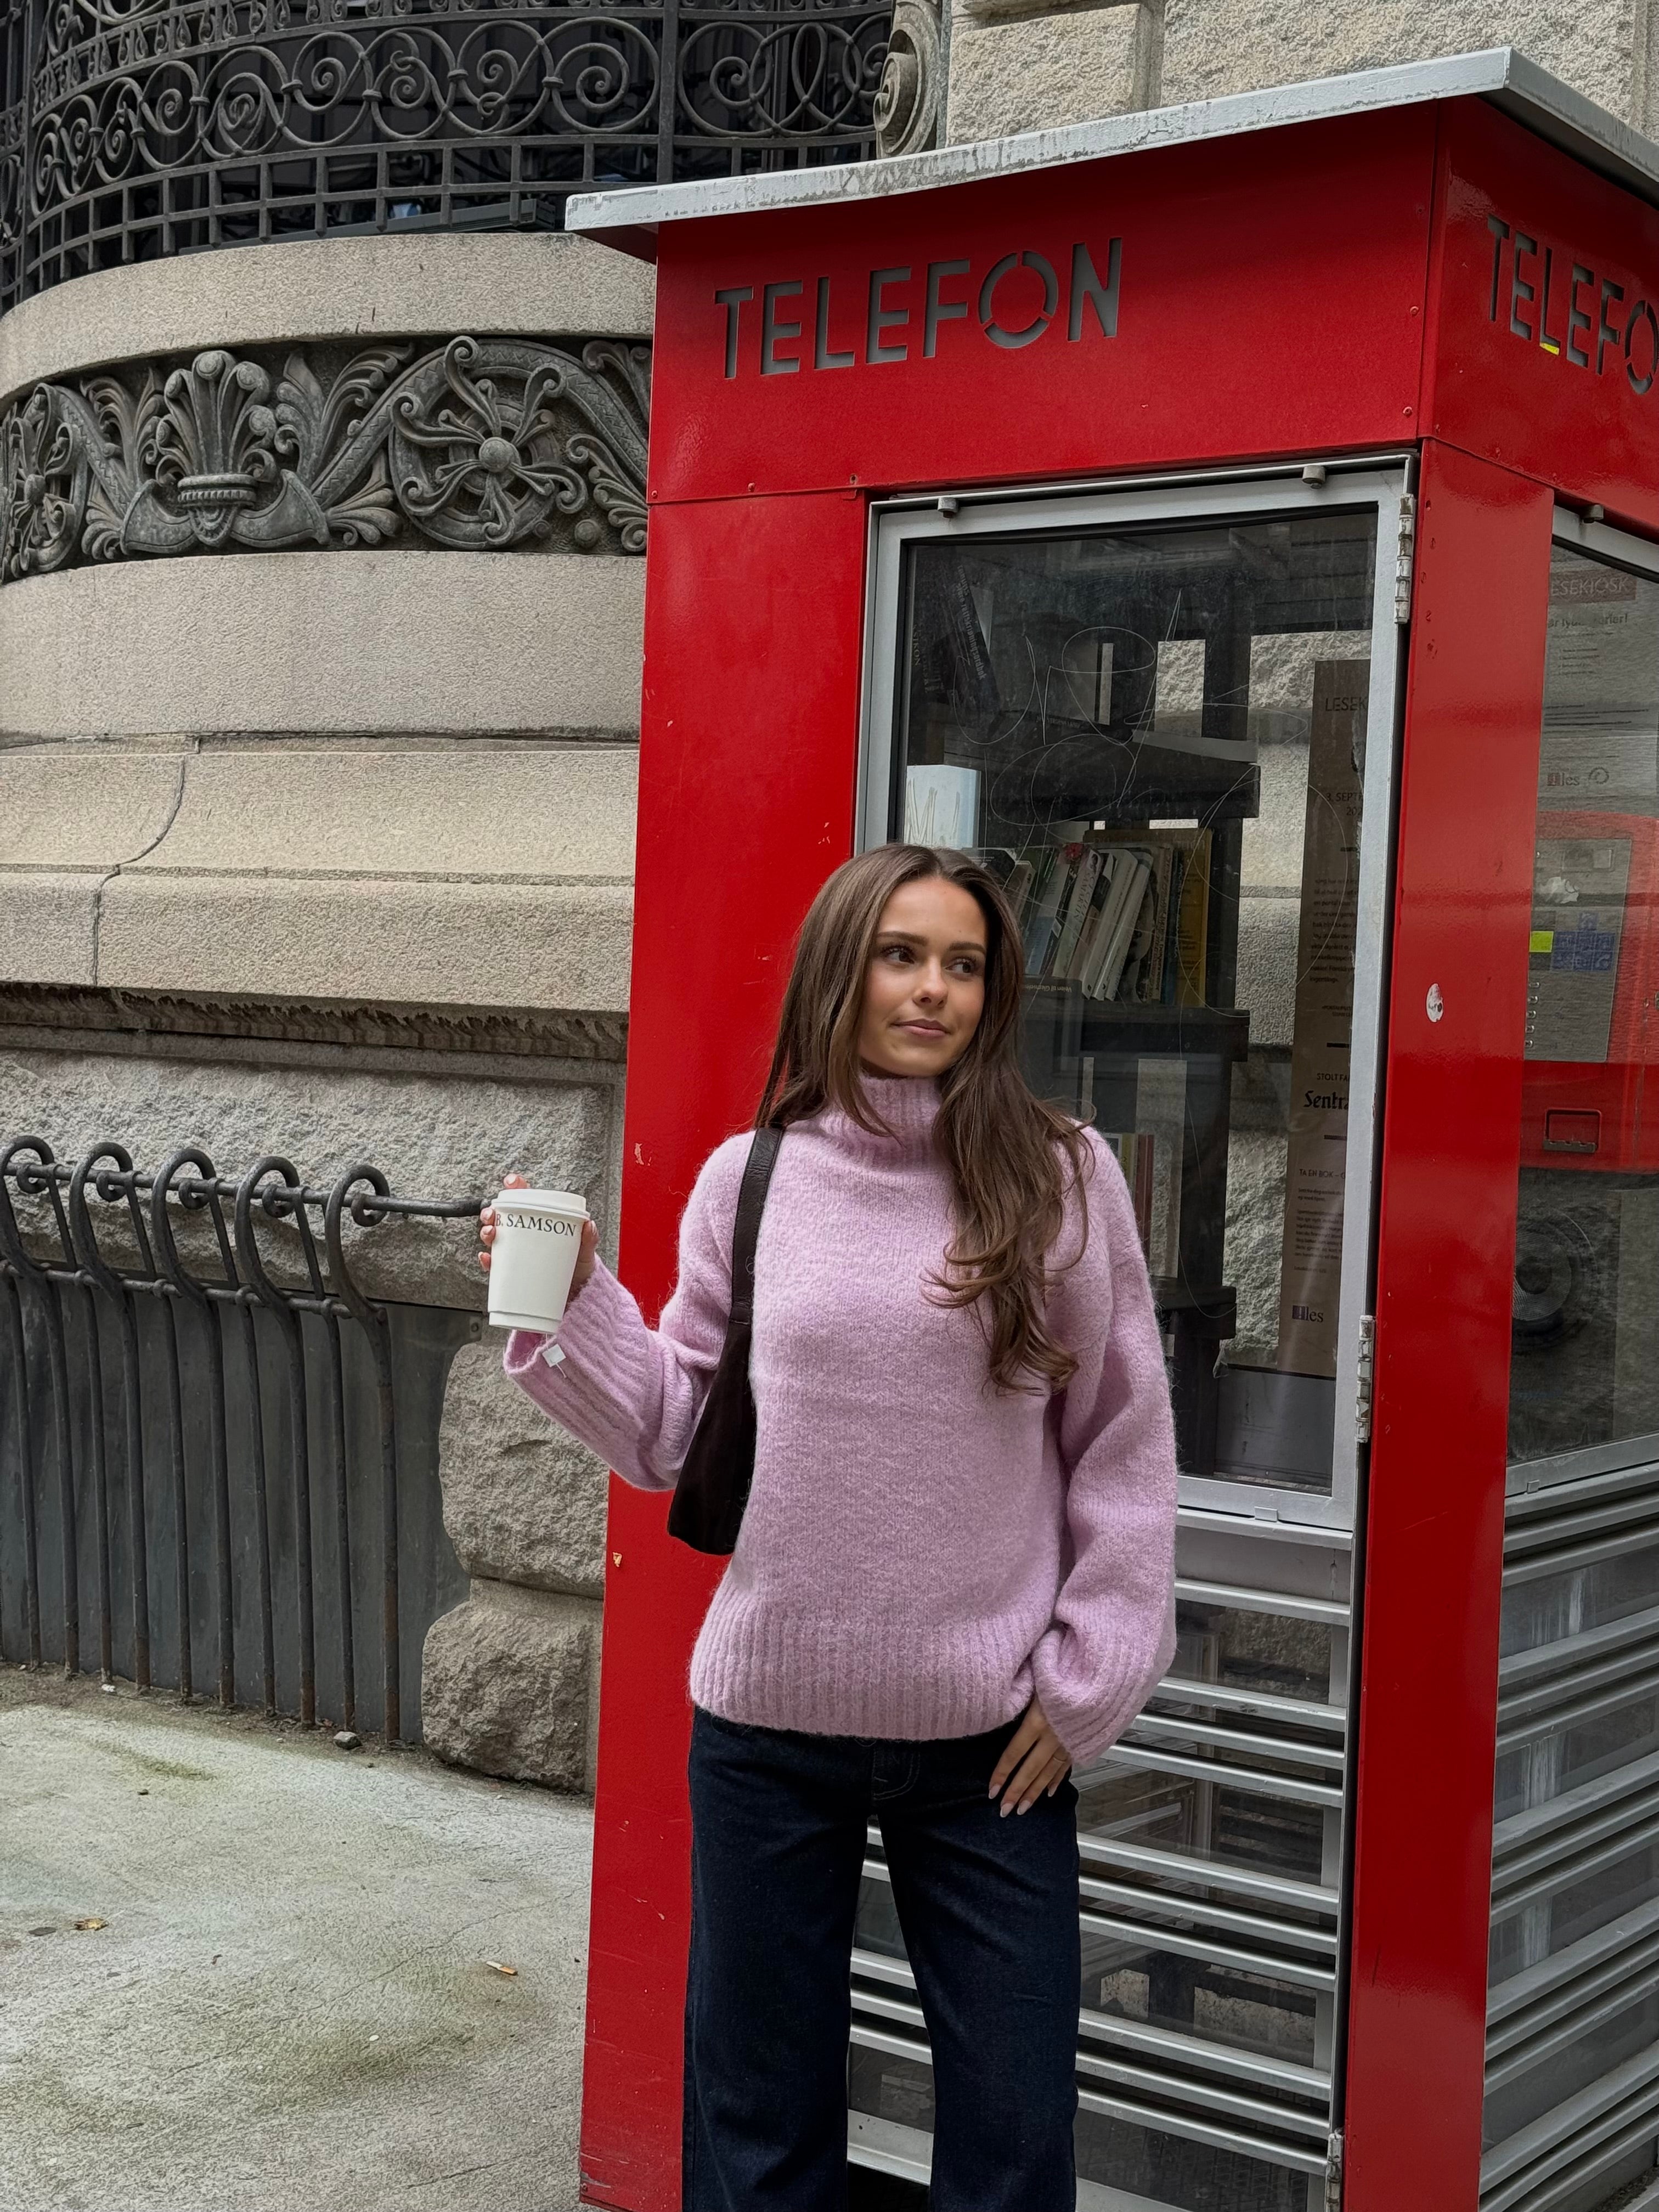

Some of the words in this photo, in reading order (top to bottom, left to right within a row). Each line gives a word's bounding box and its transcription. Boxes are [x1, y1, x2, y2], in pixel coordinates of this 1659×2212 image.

[714, 236, 1122, 380] TELEFON
[1487, 212, 1659, 396] TELEFO
[507, 1214, 577, 1237] SAMSON
